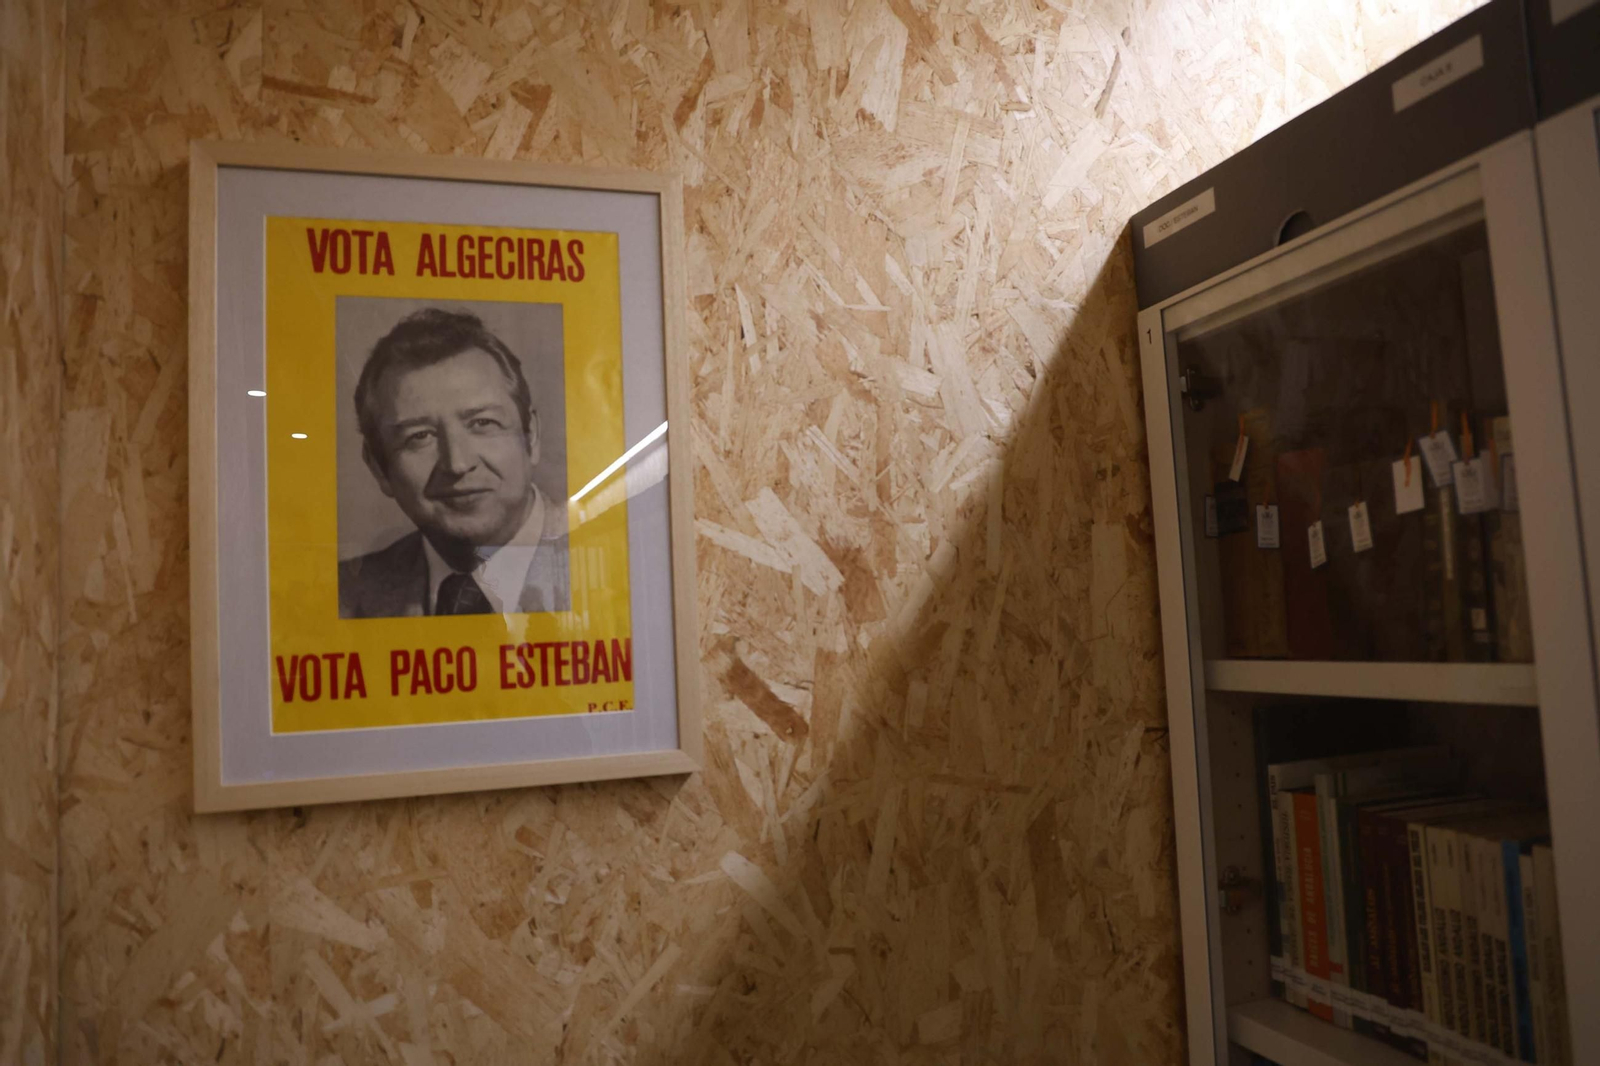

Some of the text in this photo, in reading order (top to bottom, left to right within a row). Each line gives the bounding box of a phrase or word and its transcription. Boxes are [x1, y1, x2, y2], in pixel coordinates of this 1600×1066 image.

[306, 228, 584, 282] VOTA ALGECIRAS
[1146, 327, 1152, 345] 1
[276, 637, 632, 703] VOTA PACO ESTEBAN
